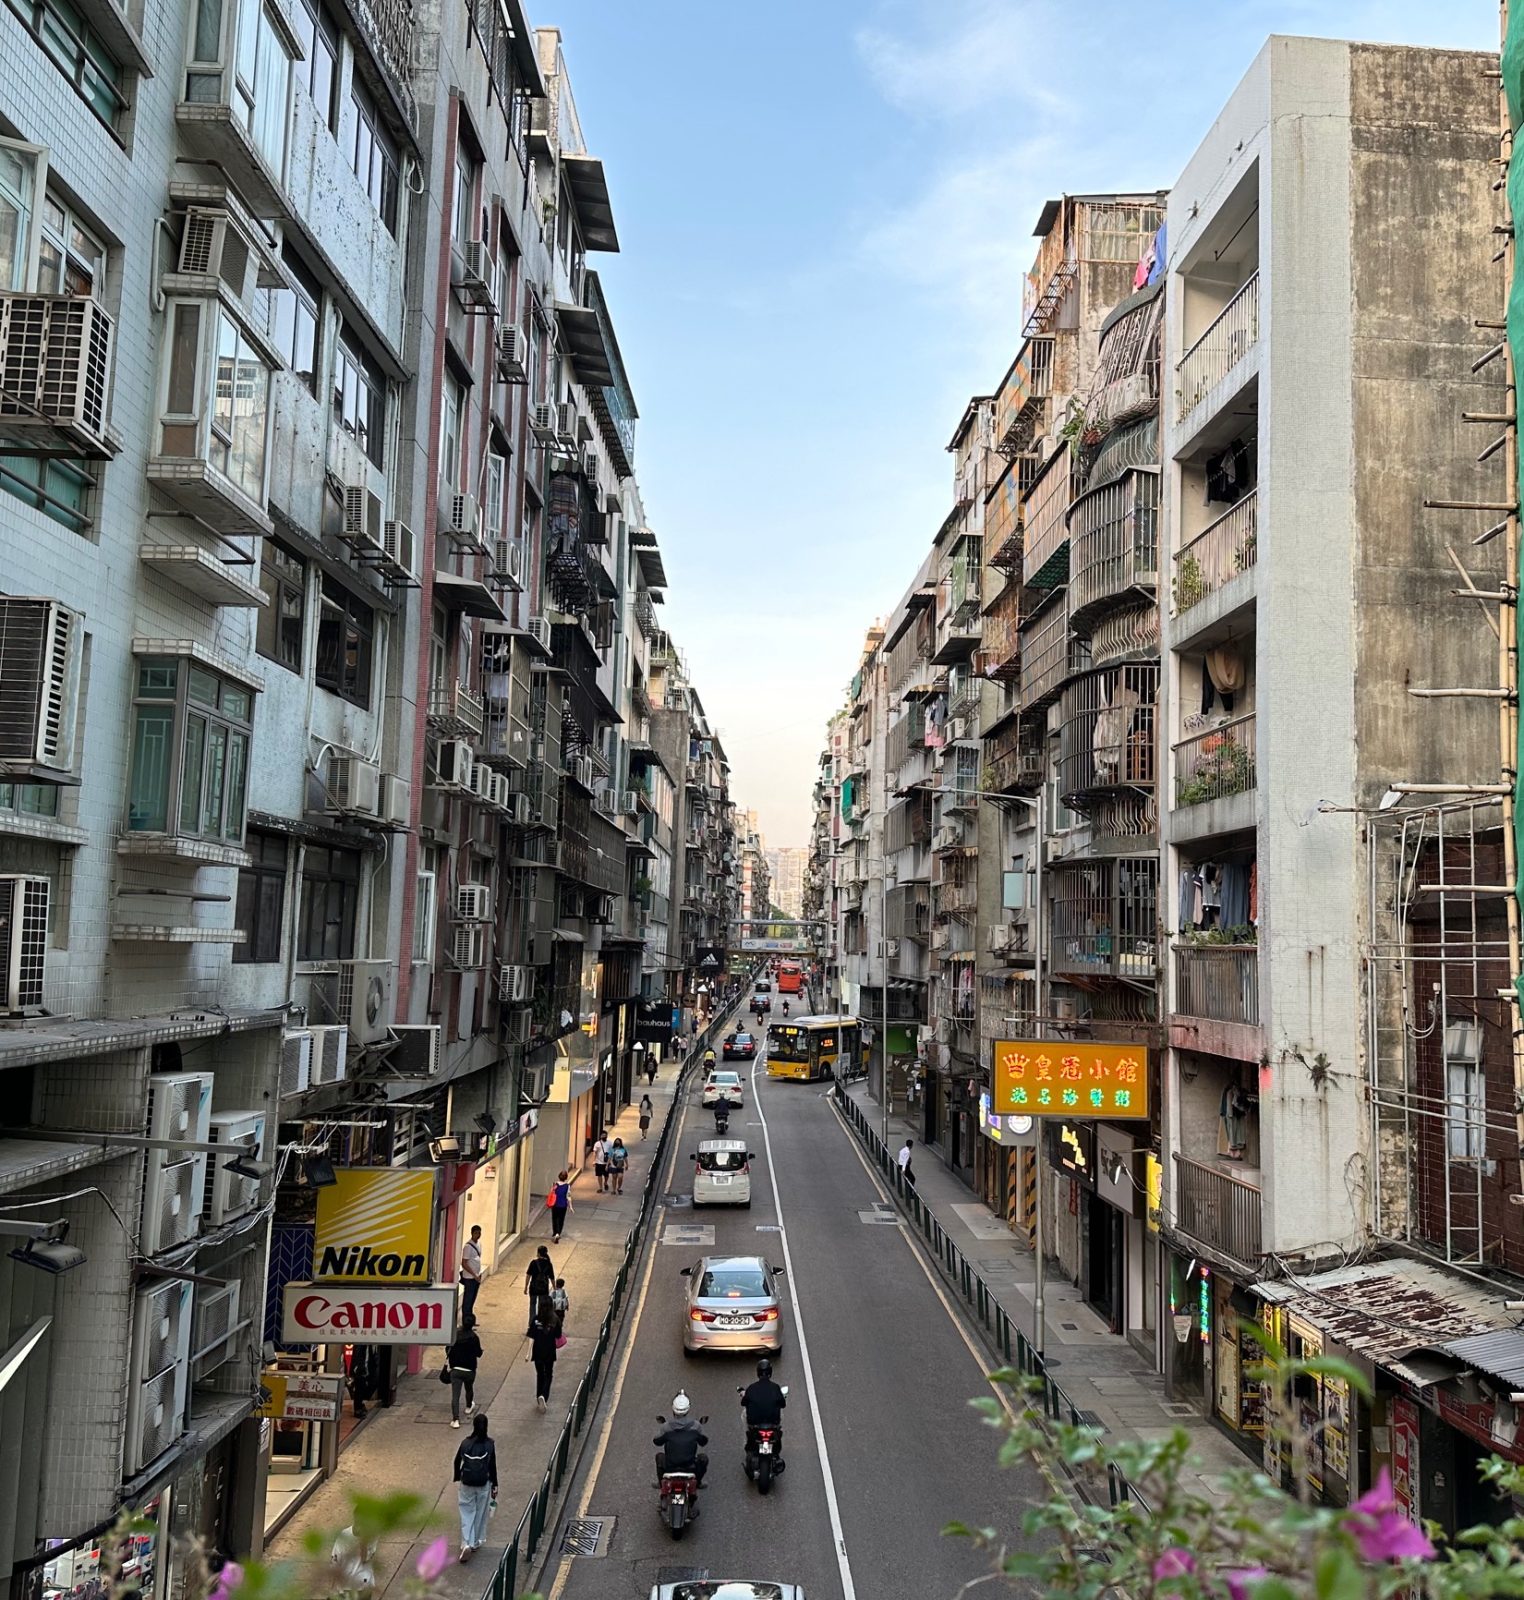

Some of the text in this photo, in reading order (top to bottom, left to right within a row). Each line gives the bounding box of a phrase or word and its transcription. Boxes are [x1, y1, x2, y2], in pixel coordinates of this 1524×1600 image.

[637, 1019, 671, 1027] bauhaus
[1034, 1054, 1139, 1083] 皇冠小館
[319, 1246, 425, 1276] Nikon
[294, 1295, 443, 1329] Canon
[298, 1380, 324, 1392] 美心
